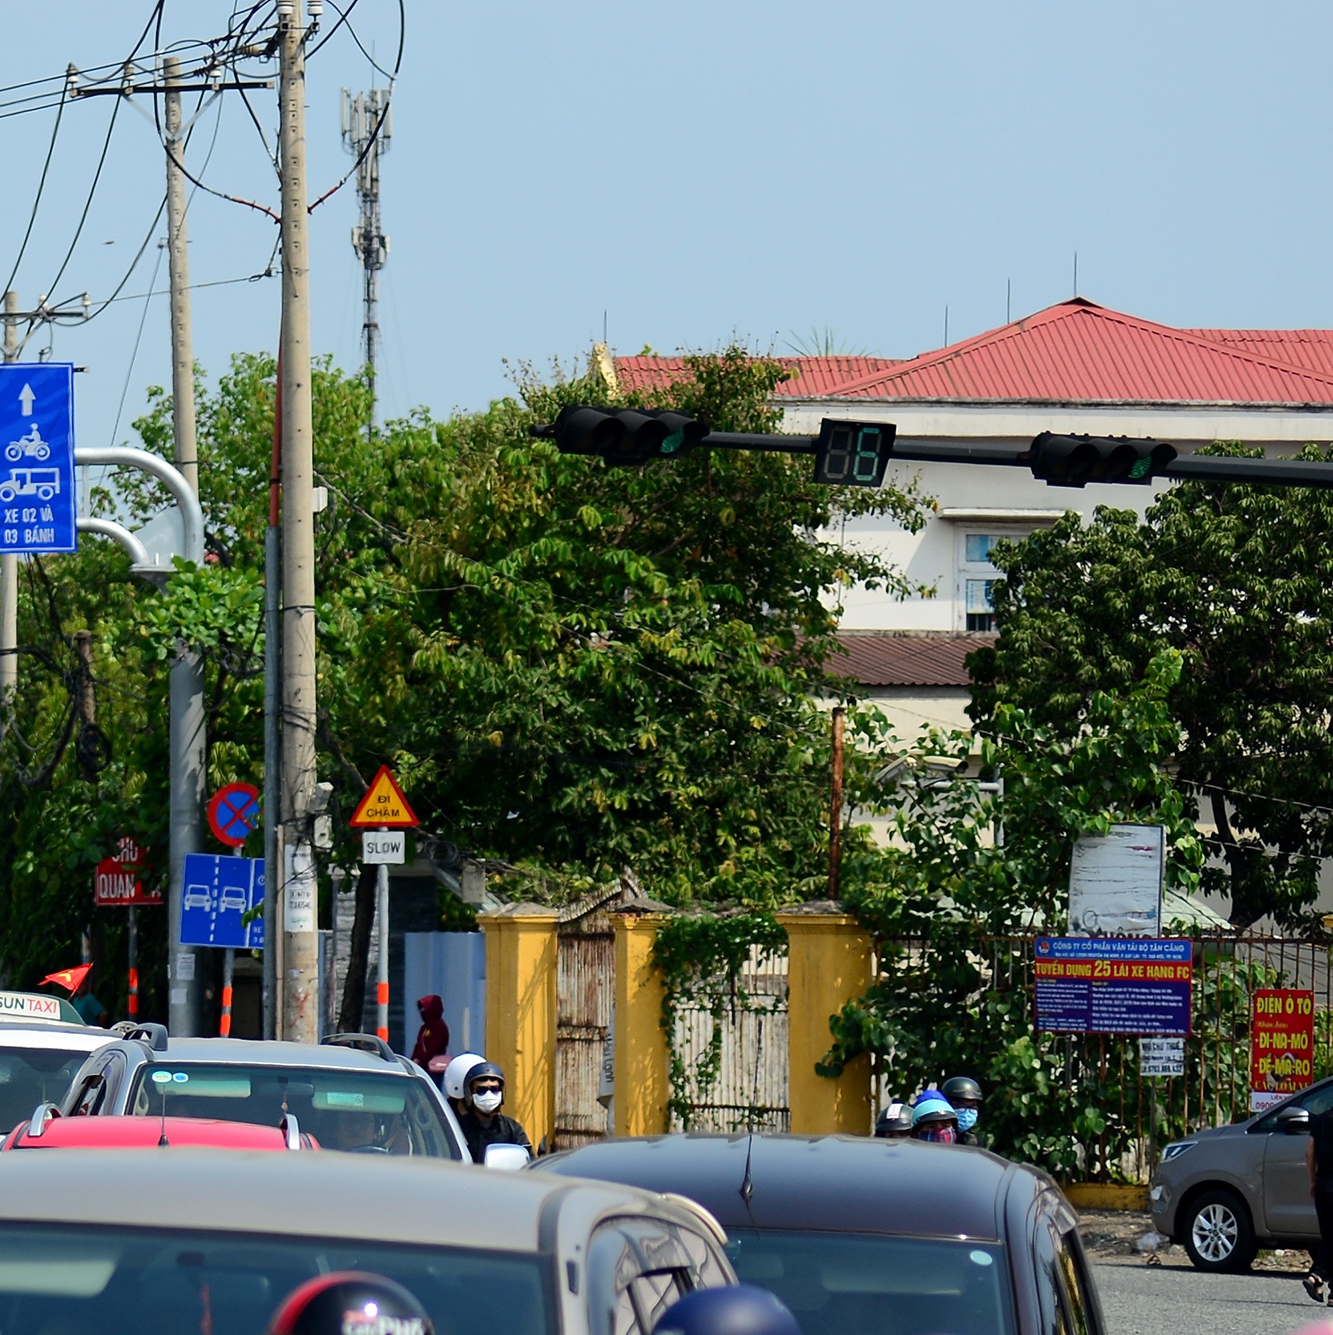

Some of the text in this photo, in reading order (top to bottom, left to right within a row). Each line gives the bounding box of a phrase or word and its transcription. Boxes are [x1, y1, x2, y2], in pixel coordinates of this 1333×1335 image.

[4, 504, 54, 523] XE 02 VÀ
[4, 524, 55, 544] 03 BÁNH
[377, 796, 391, 804] ĐI
[367, 841, 401, 854] SLOW
[99, 873, 136, 899] QUAN
[1053, 940, 1073, 950] CÔNG
[1073, 942, 1080, 950] TY
[1066, 964, 1092, 979] DỤNG
[1093, 960, 1111, 977] 25
[1113, 962, 1129, 978] LÁI
[1131, 966, 1145, 978] XE
[1147, 966, 1174, 981] HẠNG
[1177, 966, 1190, 980] FC
[1256, 994, 1312, 1018] ĐIỆN Ô TÔ
